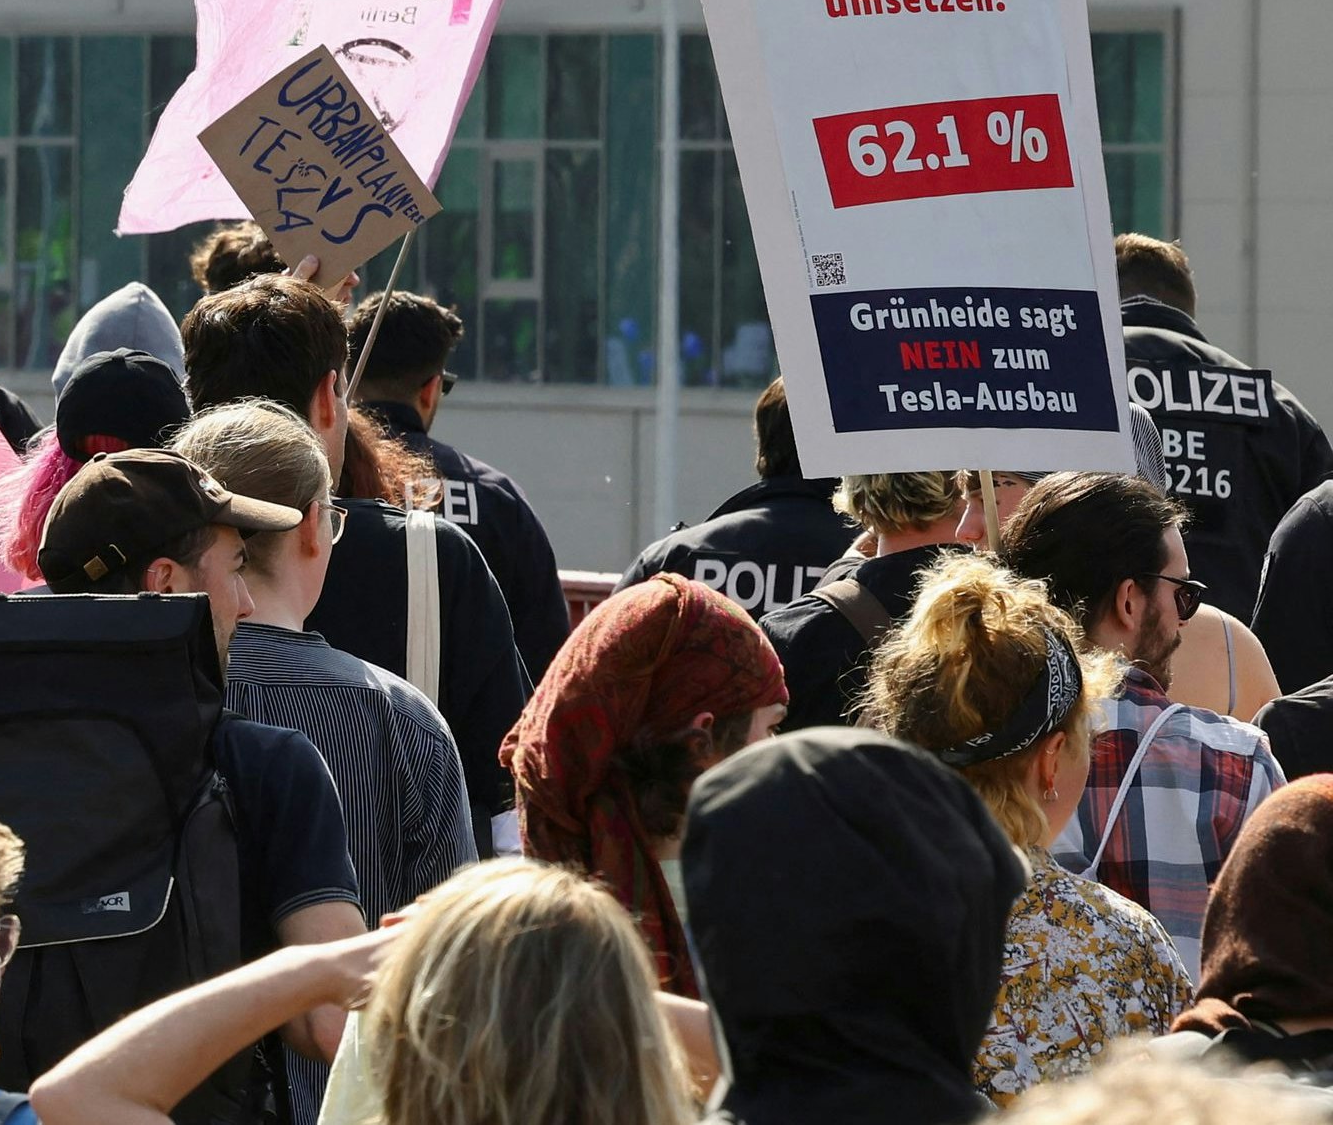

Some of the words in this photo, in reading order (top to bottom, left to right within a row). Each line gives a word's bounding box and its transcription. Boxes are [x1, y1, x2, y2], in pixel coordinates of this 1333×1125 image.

[846, 115, 969, 177] 62.1
[986, 110, 1049, 163] %
[850, 296, 1010, 332] Grünheide
[1020, 304, 1077, 336] sagt
[899, 340, 981, 371] NEIN
[992, 346, 1050, 371] zum
[879, 383, 1077, 415] Tesla-Ausbau
[1127, 367, 1270, 418] OLIZEI
[1163, 428, 1206, 461] BE
